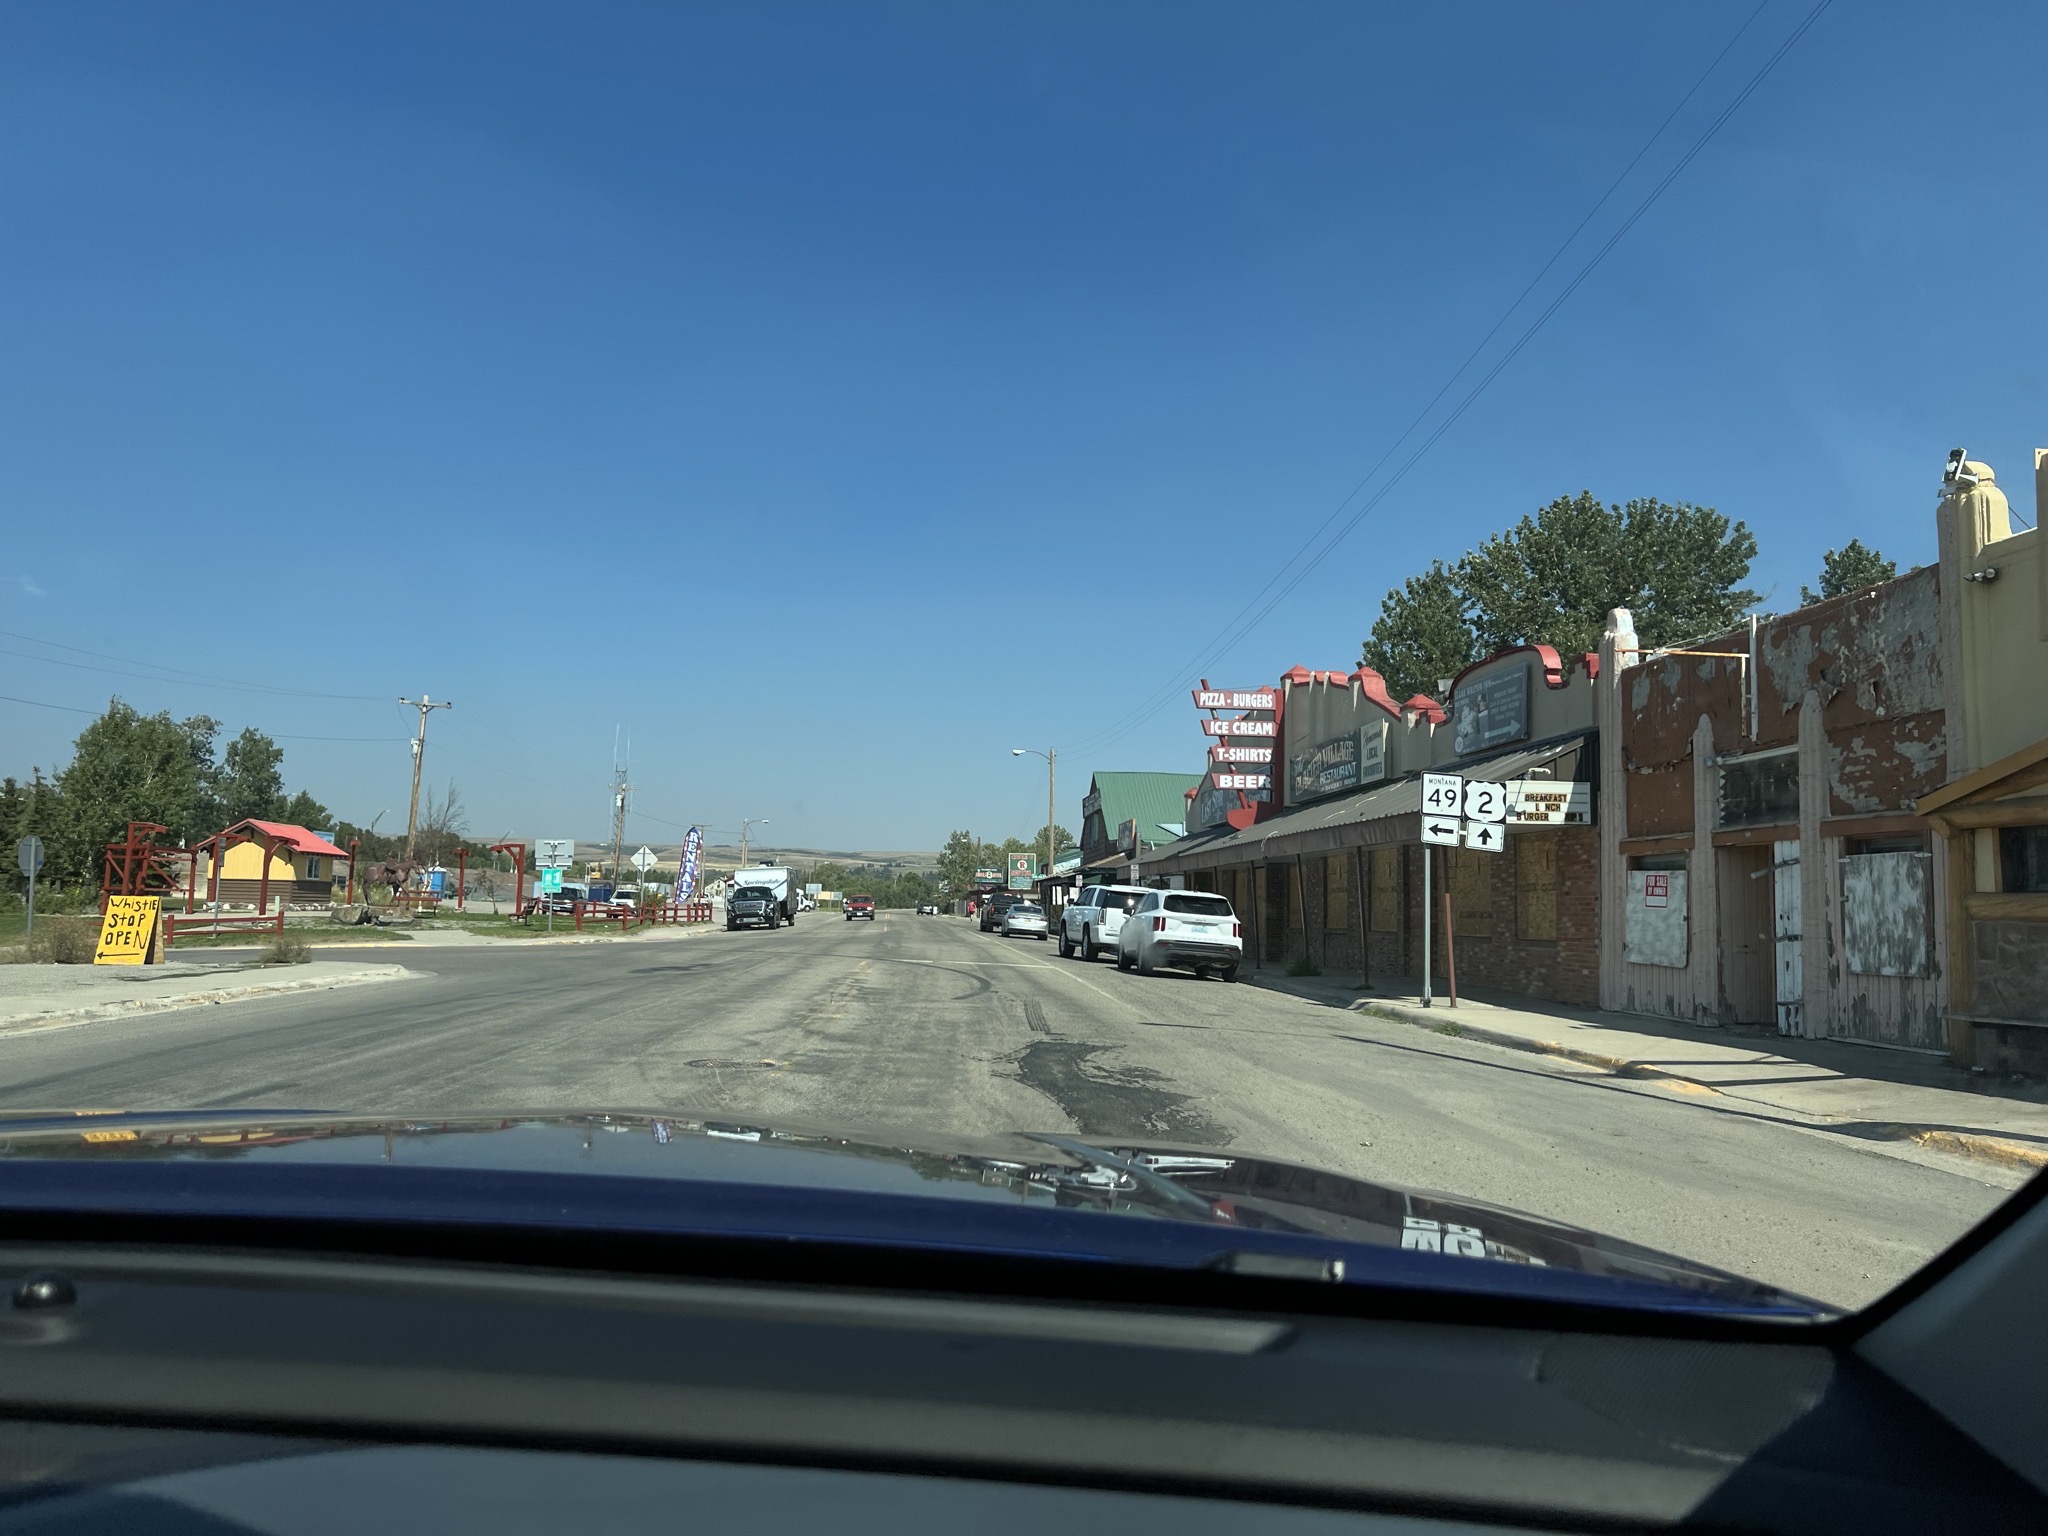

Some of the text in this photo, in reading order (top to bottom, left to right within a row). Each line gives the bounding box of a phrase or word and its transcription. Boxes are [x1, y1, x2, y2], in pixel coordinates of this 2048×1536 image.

[1200, 692, 1273, 708] PIZZA BURGERS
[1210, 721, 1272, 735] ICE CREAM
[1217, 748, 1272, 762] T-SHIRTS
[1295, 741, 1354, 796] GLACIER VILLAGE
[1319, 762, 1357, 785] RESTAURANT
[1219, 775, 1271, 788] BEER
[1428, 778, 1457, 787] MONTANA
[1428, 789, 1457, 808] 49
[1478, 791, 1493, 814] 2
[1524, 793, 1568, 803] BREAKFAST
[679, 832, 699, 902] RENTALS
[105, 930, 149, 949] OPEN
